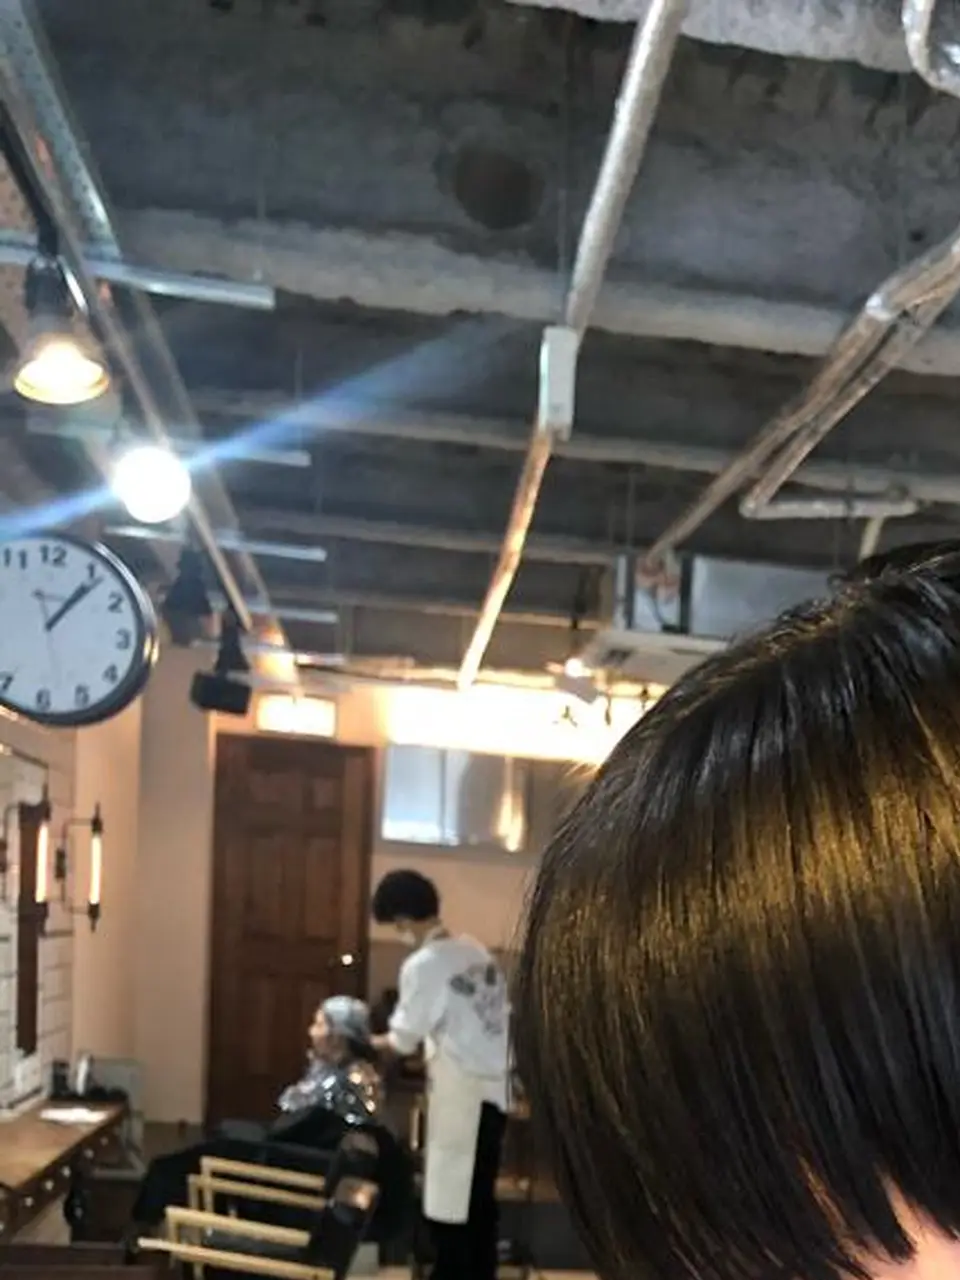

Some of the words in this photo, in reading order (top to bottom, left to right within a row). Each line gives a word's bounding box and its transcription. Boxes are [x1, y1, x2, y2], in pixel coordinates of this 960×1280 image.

[3, 547, 28, 571] 11
[40, 544, 67, 568] 12
[107, 592, 123, 613] 2
[116, 629, 131, 650] 3
[103, 664, 118, 683] 4
[36, 688, 51, 710] 6
[74, 684, 90, 707] 5
